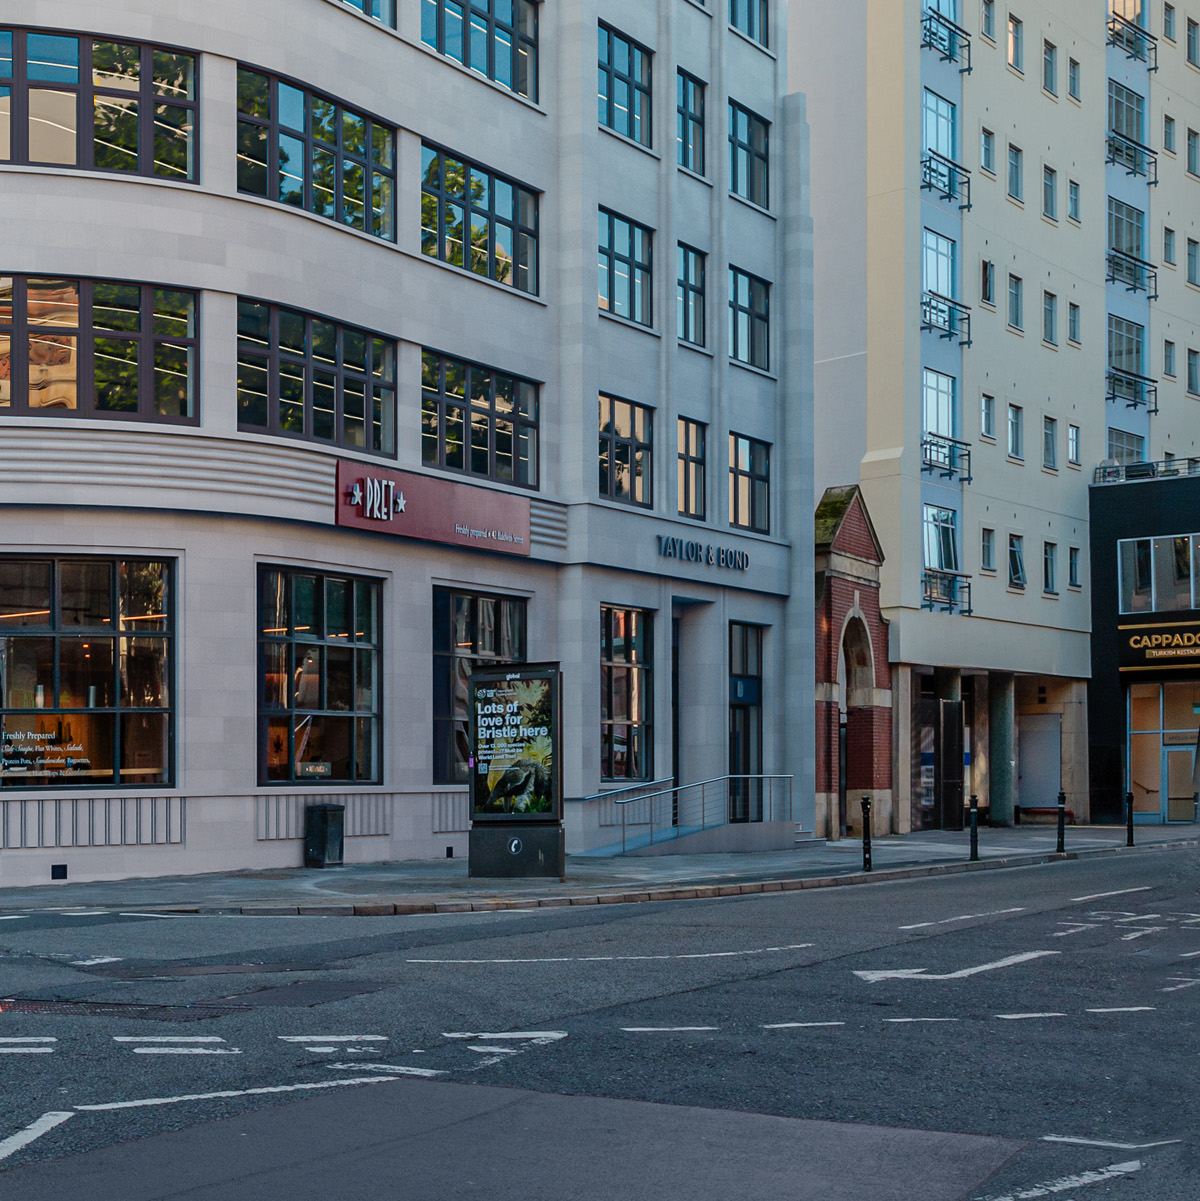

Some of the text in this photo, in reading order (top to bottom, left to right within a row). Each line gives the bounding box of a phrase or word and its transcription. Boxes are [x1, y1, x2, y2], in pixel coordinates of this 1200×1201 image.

[366, 476, 396, 522] PRET
[656, 534, 751, 572] TAYLOR & BOND
[1151, 649, 1176, 657] TURKISH
[506, 672, 520, 681] global
[478, 701, 519, 715] Lots of
[478, 714, 523, 727] love for
[2, 731, 56, 741] Freshly Prepared
[478, 725, 549, 739] Bristle here
